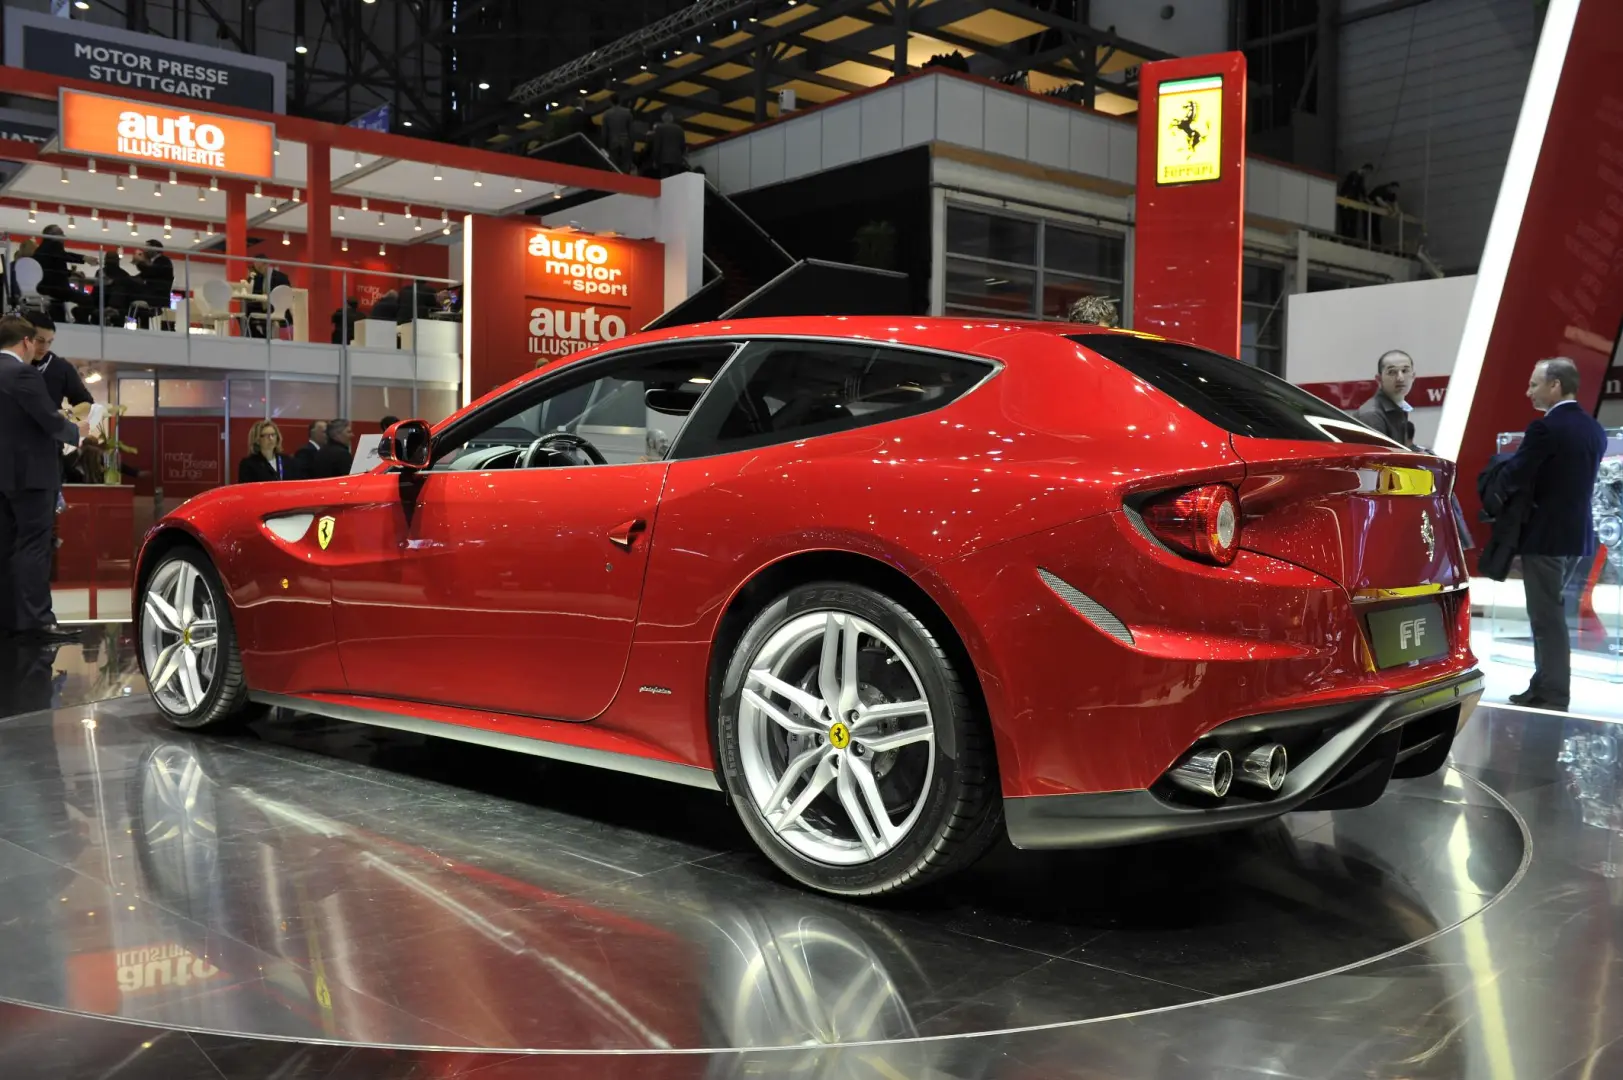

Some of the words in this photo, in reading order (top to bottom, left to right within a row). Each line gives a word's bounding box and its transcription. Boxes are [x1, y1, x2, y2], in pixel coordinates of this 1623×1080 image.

[74, 43, 152, 71] MOTOR
[158, 59, 228, 85] PRESSE
[89, 65, 215, 100] STUTTGART
[117, 111, 225, 151] auto
[117, 137, 225, 167] ILLUSTRIERTE
[528, 233, 608, 265] auto
[545, 260, 622, 281] motor
[573, 279, 628, 296] sport
[529, 307, 626, 342] auto
[528, 337, 600, 356] ILLUSTR
[164, 452, 193, 462] motor
[1400, 618, 1426, 650] FF
